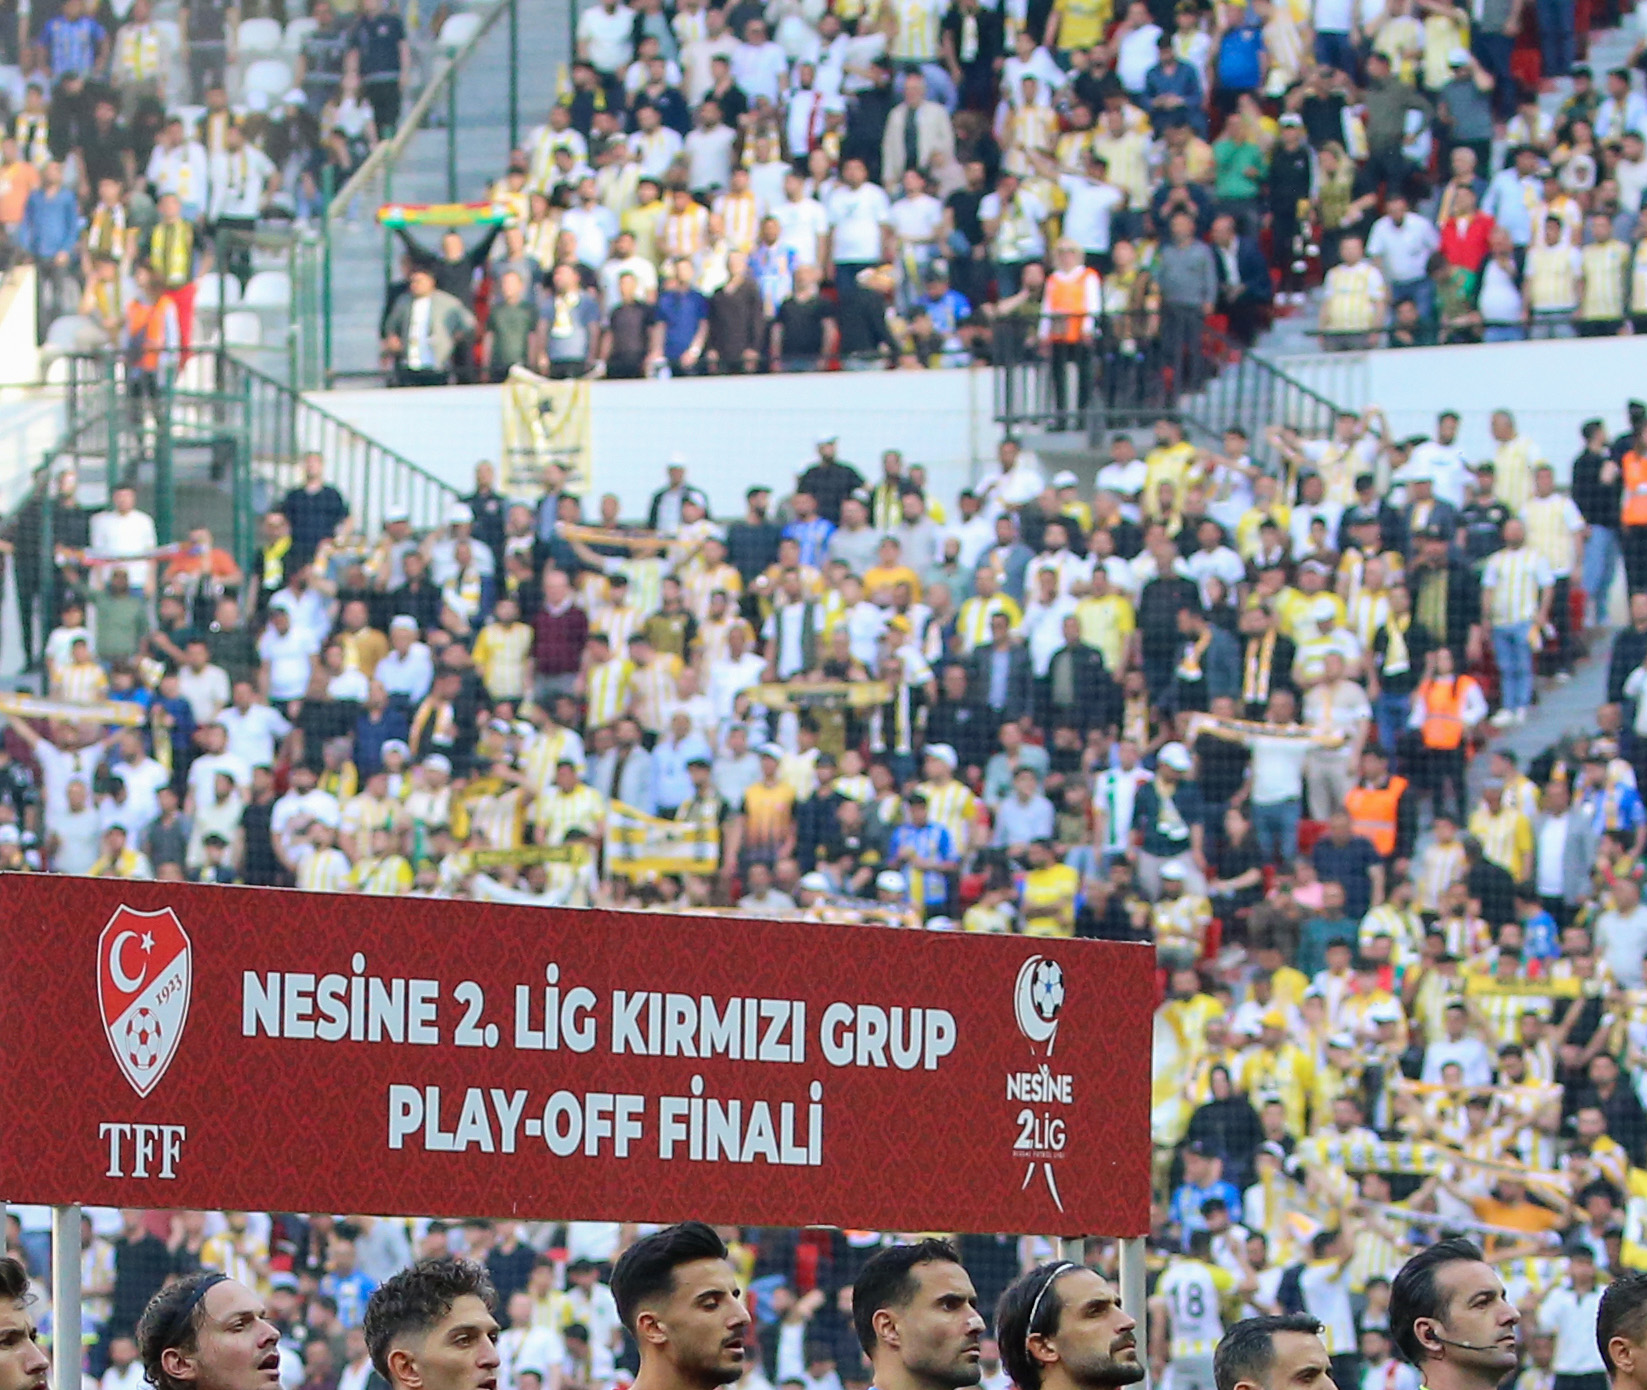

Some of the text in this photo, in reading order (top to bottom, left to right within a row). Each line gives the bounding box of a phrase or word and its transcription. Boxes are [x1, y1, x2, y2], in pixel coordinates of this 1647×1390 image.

[153, 972, 185, 1007] 1923
[241, 951, 958, 1072] NESİNE 2. LİG KIRMIZI GRUP
[1006, 1063, 1074, 1104] NESİNE
[387, 1073, 823, 1167] PLAY-OFF FİNALİ
[99, 1122, 187, 1180] TFF
[1168, 1281, 1206, 1319] 18
